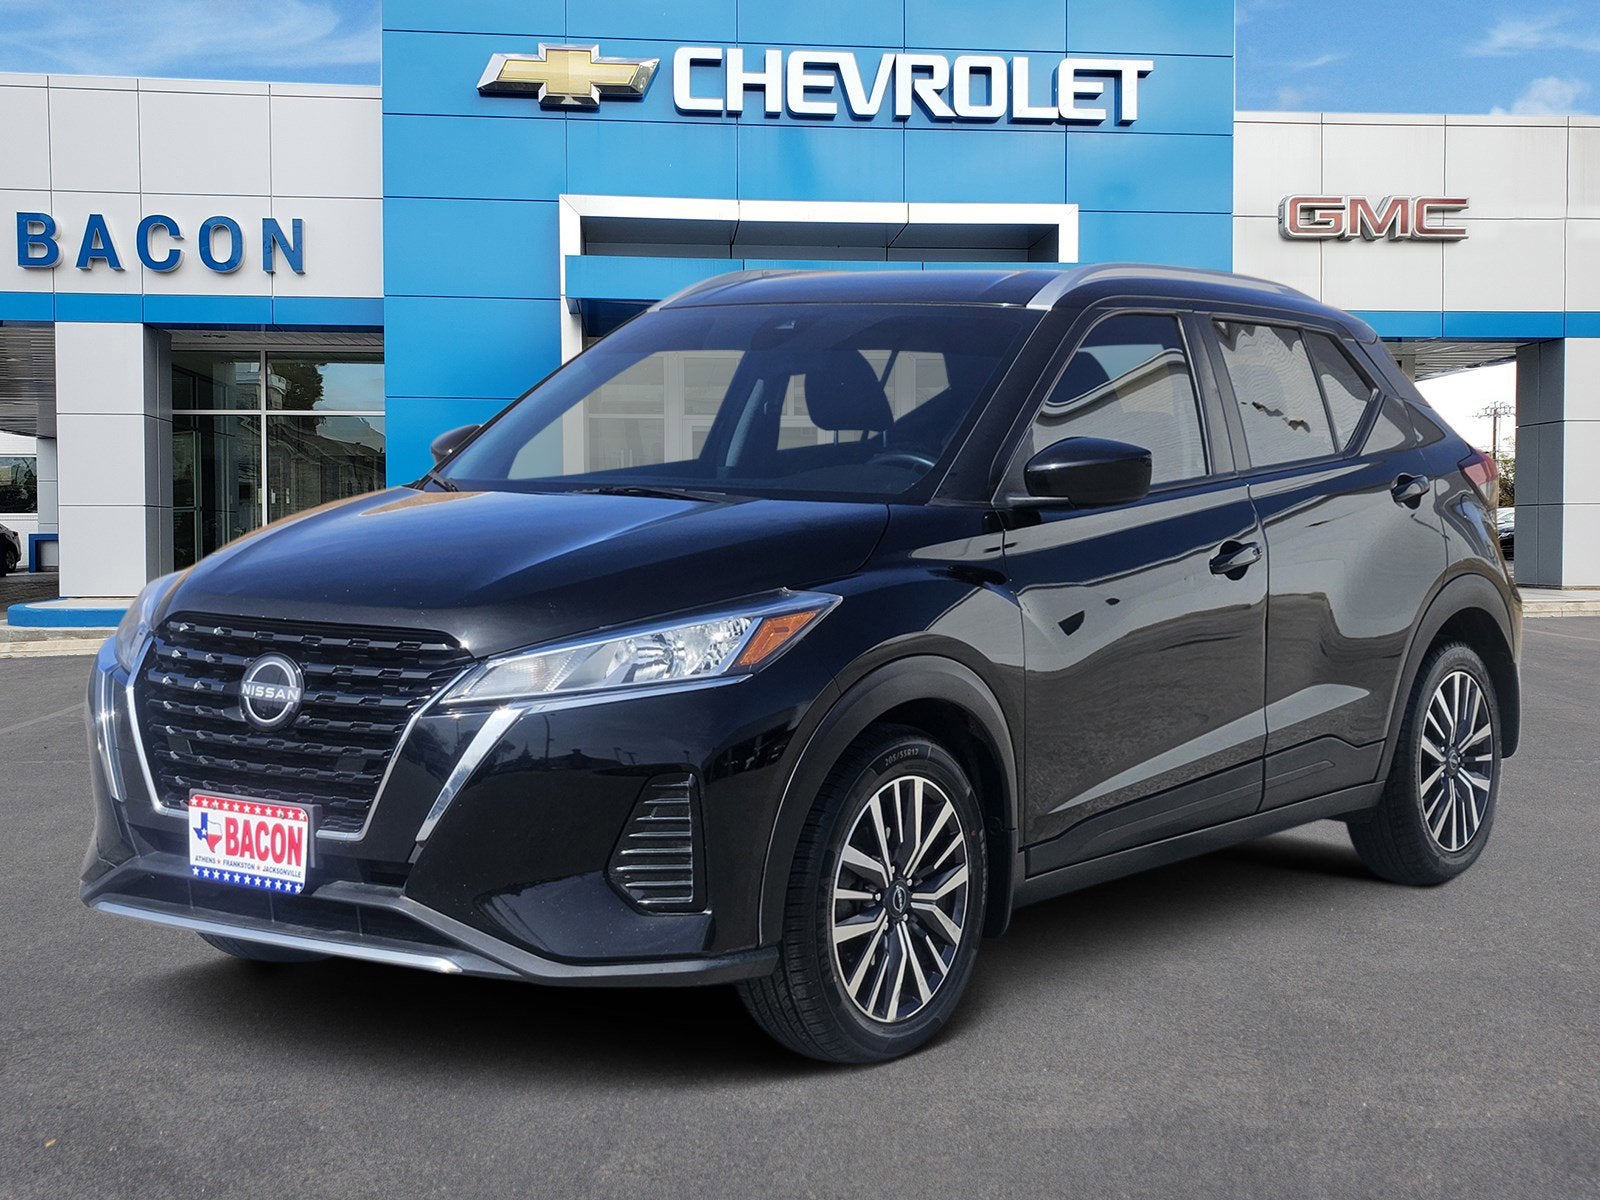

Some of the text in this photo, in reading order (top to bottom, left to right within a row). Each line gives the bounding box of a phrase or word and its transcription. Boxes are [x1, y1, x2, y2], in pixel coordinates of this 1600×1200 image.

[673, 46, 1154, 126] CHEVROLET
[1278, 194, 1469, 242] GMC
[16, 211, 305, 275] BACON
[242, 683, 299, 700] NISSAN
[225, 816, 303, 867] BACON
[194, 855, 301, 878] ATHENS FRANKSTON JACKSONVILLE
